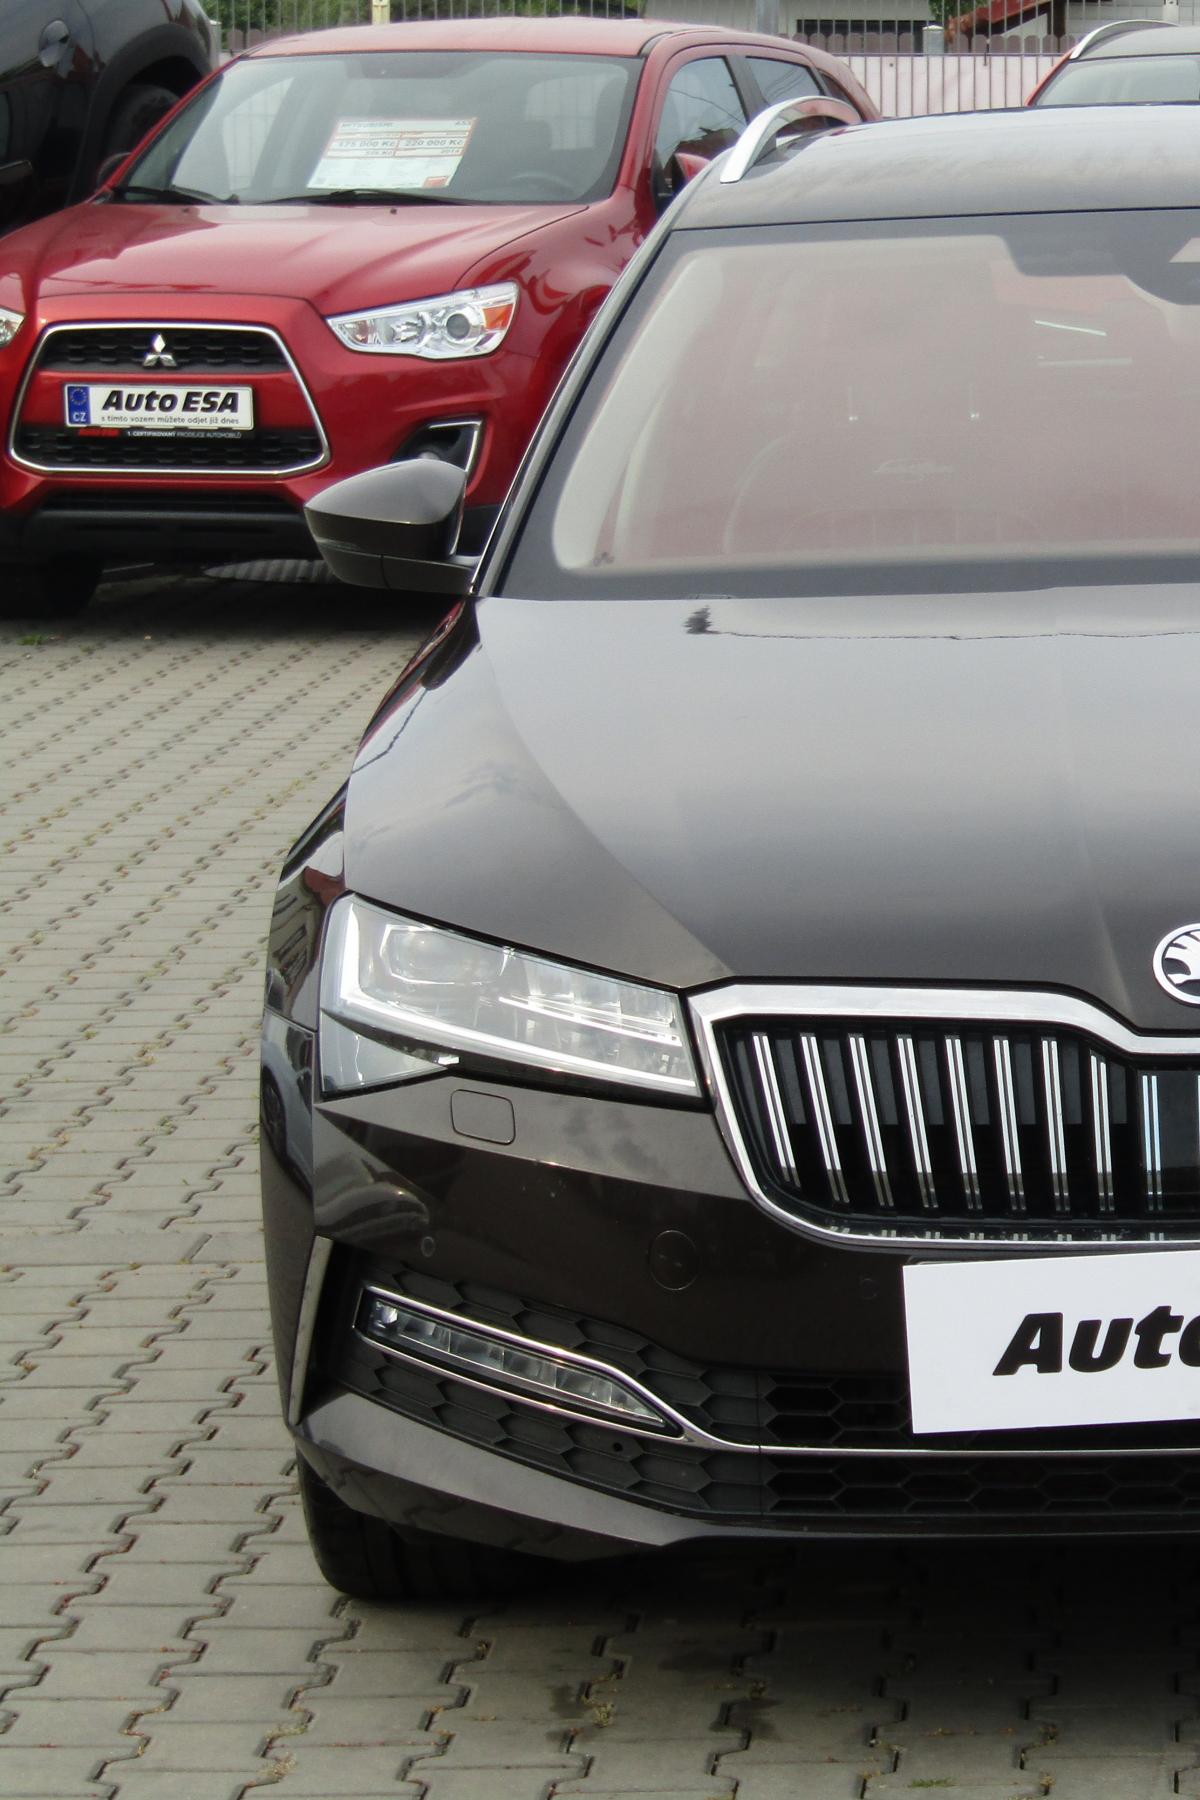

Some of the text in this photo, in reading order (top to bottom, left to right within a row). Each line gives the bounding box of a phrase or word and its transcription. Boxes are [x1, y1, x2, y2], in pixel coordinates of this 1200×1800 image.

[102, 389, 239, 413] Auto ESA
[72, 411, 87, 423] CZ
[187, 417, 208, 425] odjet
[220, 417, 240, 425] dnes
